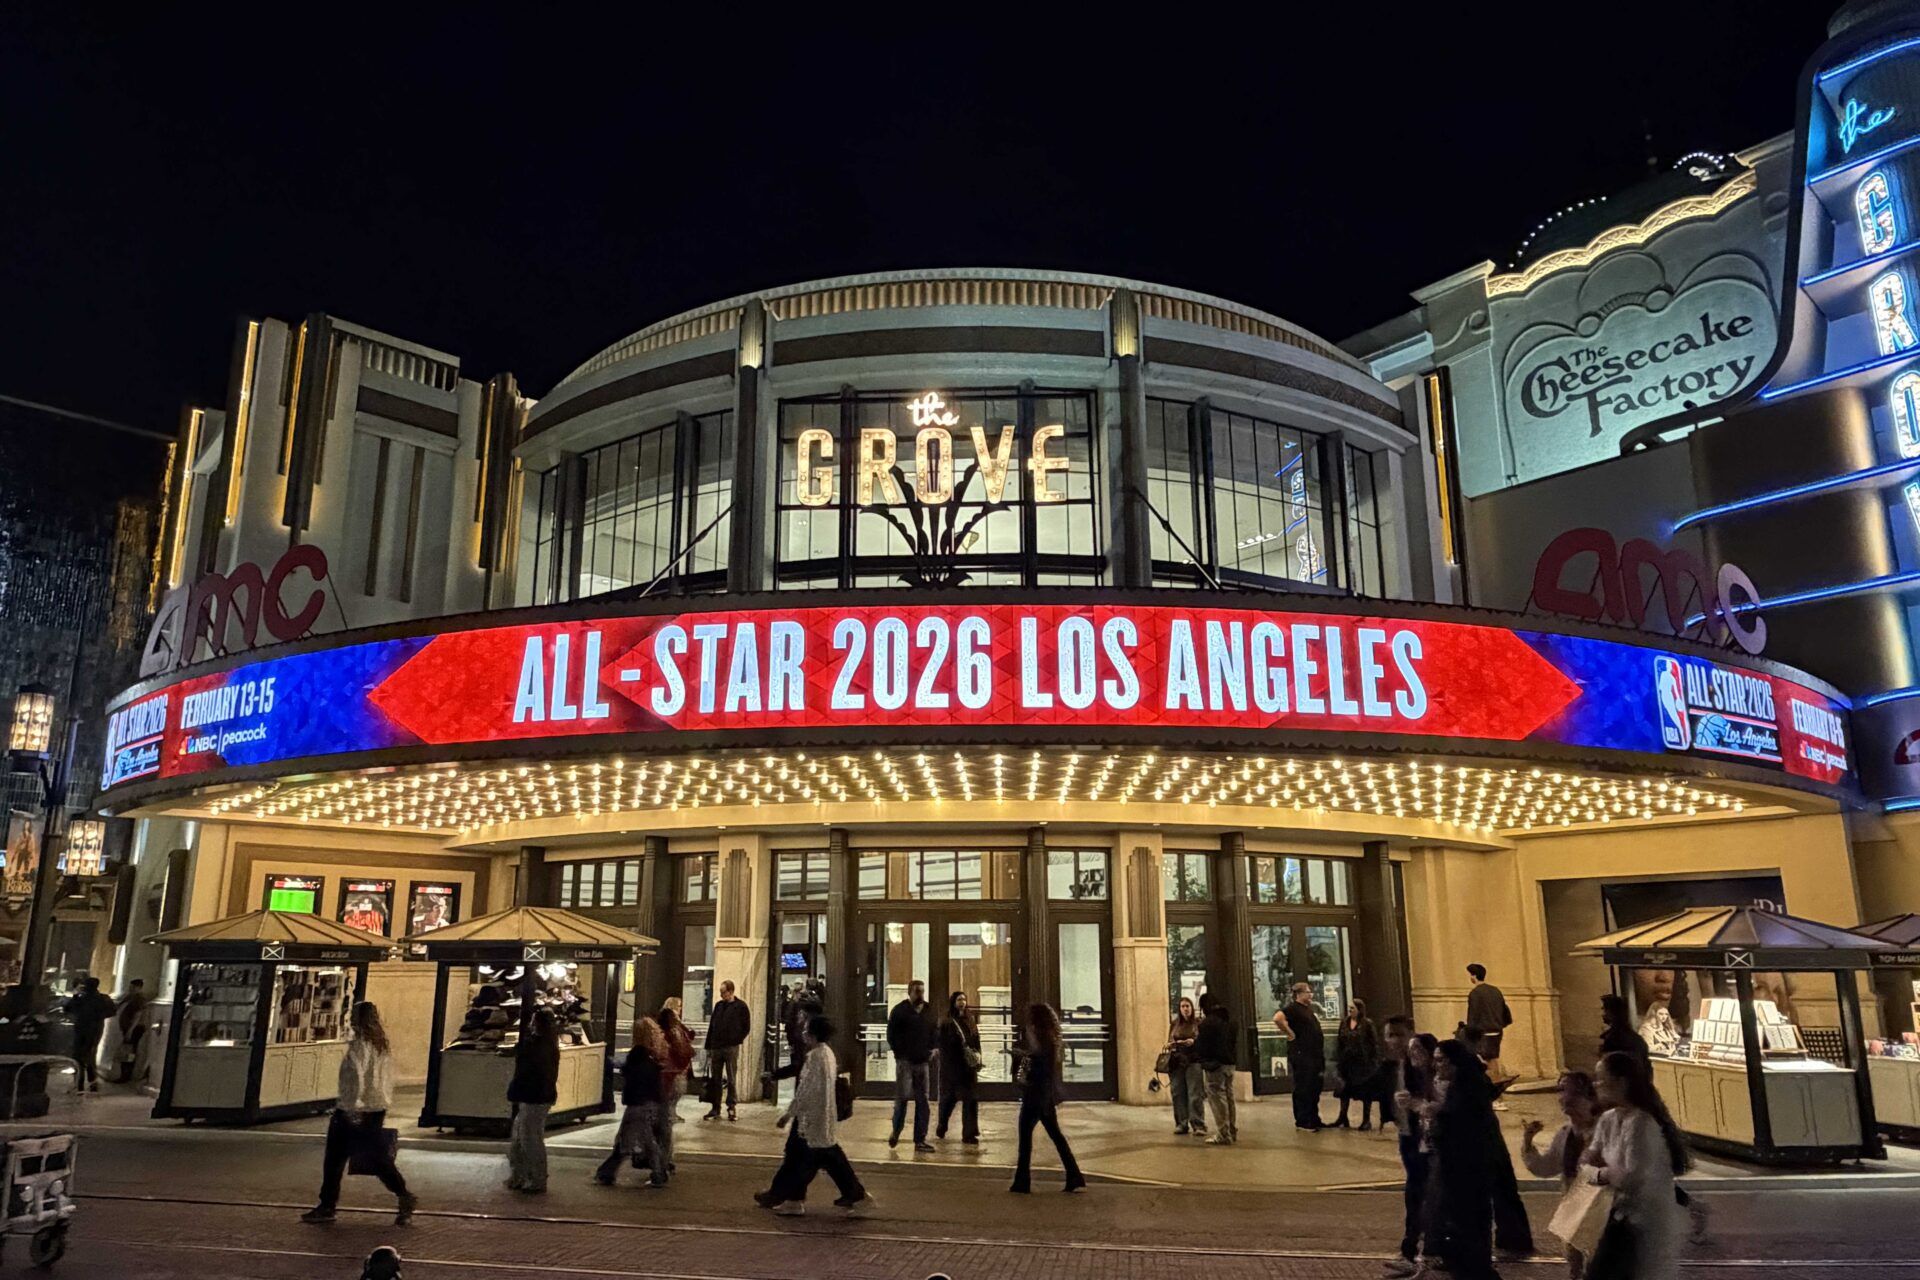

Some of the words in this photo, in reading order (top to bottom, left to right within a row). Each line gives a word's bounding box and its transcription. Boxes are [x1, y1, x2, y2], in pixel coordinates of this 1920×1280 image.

[1839, 97, 1897, 154] the
[1521, 311, 1754, 419] Cheesecake
[1569, 344, 1608, 368] The
[905, 391, 960, 427] the
[1565, 354, 1756, 438] Factory
[796, 424, 1070, 507] GROVE
[1533, 531, 1768, 655] amc
[830, 616, 991, 711] 2026
[1020, 615, 1141, 711] LOS
[1165, 618, 1428, 720] ANGELES
[1685, 663, 1711, 707] ALL
[181, 684, 241, 730] FEBRUARY
[239, 677, 276, 718] 13-15
[194, 734, 217, 752] NBC
[221, 722, 267, 749] peacock
[1724, 722, 1739, 745] Los
[1741, 726, 1778, 756] Angeles
